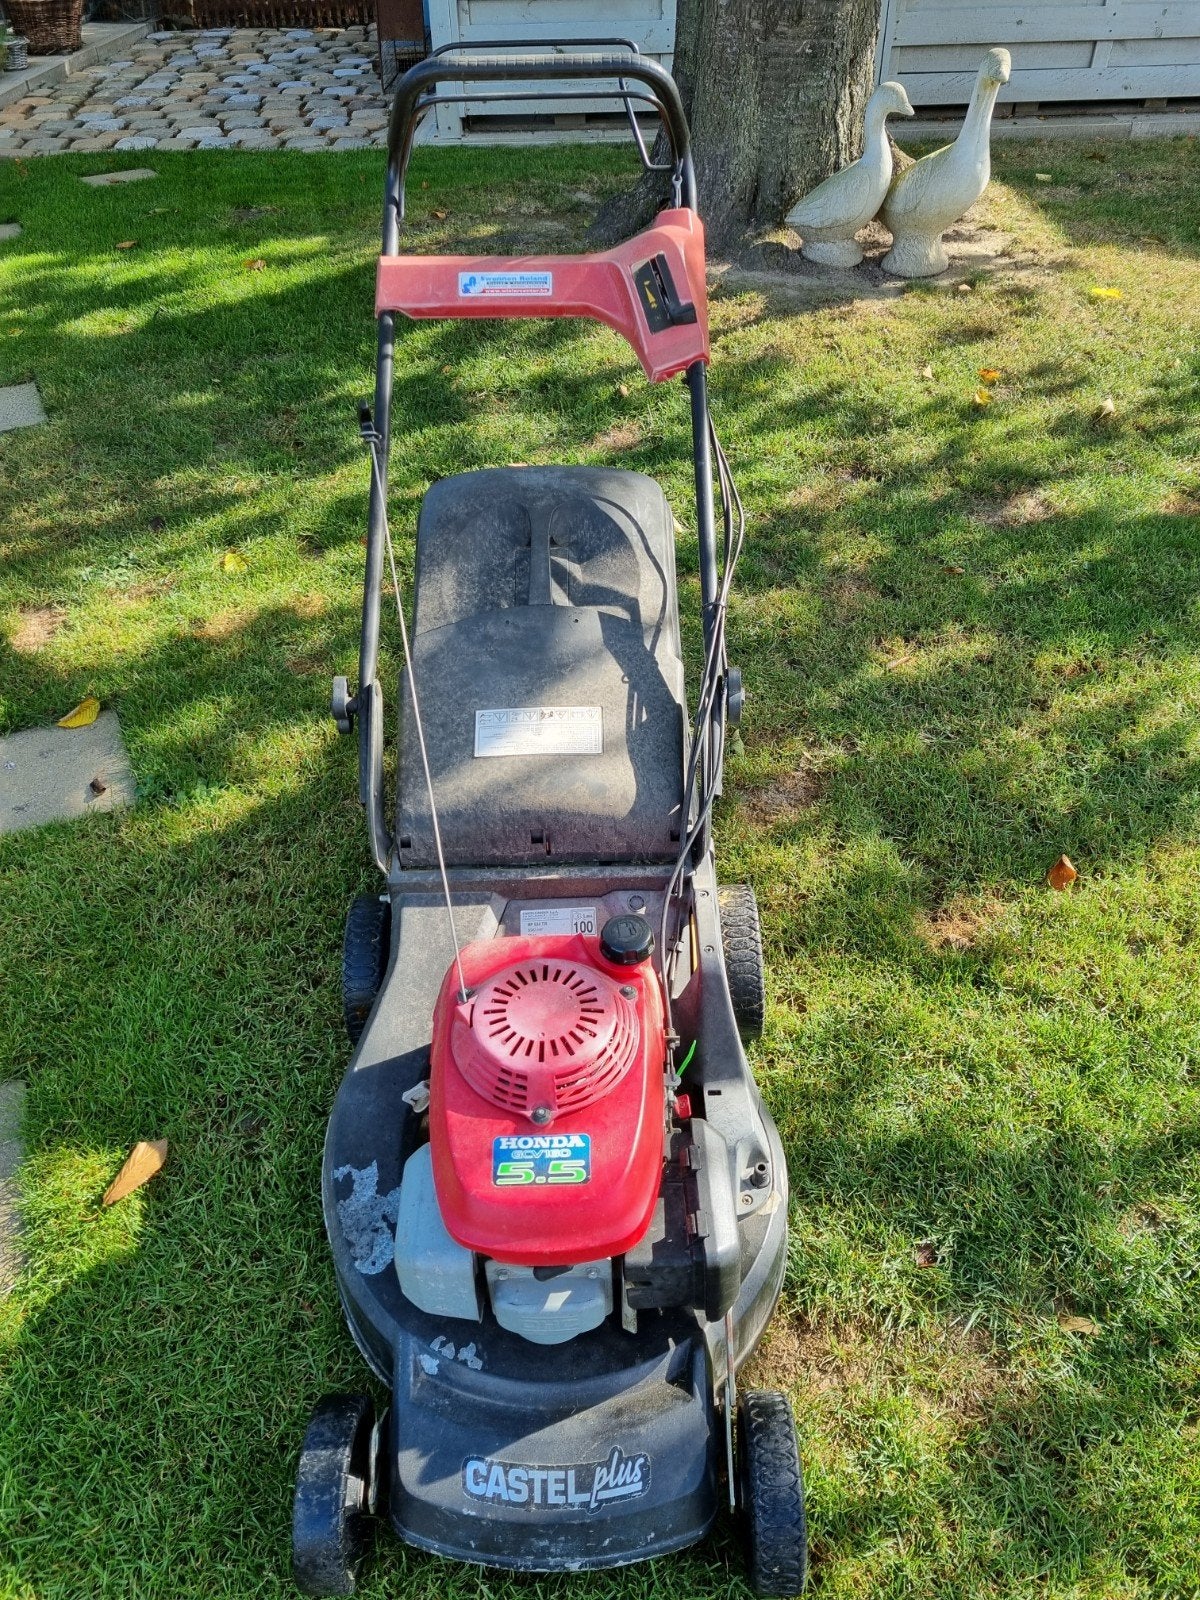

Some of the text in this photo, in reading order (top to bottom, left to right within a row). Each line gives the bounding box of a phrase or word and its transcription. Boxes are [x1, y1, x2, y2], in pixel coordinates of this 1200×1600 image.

[574, 920, 593, 933] 100
[500, 1136, 586, 1150] HONDA
[496, 1160, 586, 1185] 5.5
[466, 1451, 645, 1508] CASTEL plus
